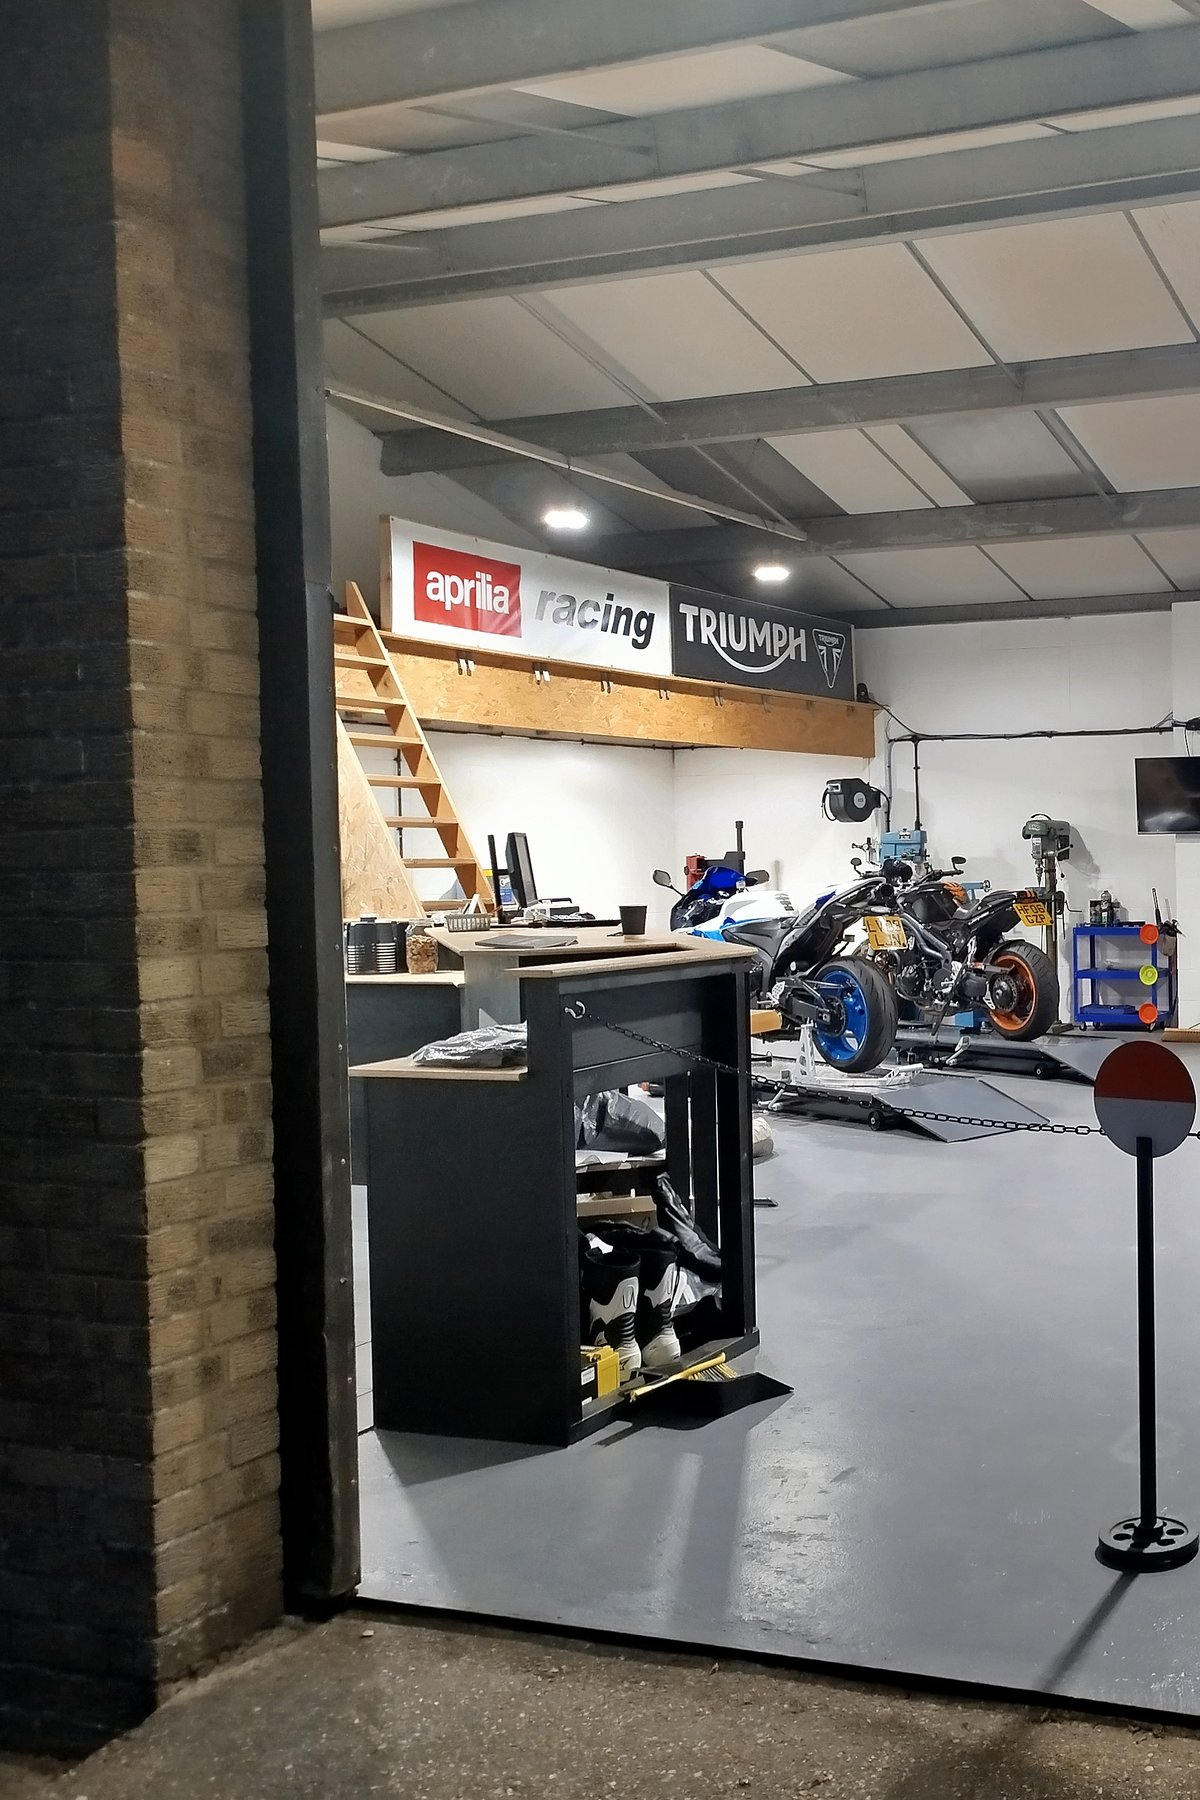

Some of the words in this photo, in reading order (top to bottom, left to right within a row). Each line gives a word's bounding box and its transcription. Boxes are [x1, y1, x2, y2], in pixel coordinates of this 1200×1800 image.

[425, 568, 510, 615] aprilia
[534, 585, 655, 650] racing
[679, 603, 807, 673] TRIUMPH
[1025, 914, 1046, 924] GZP
